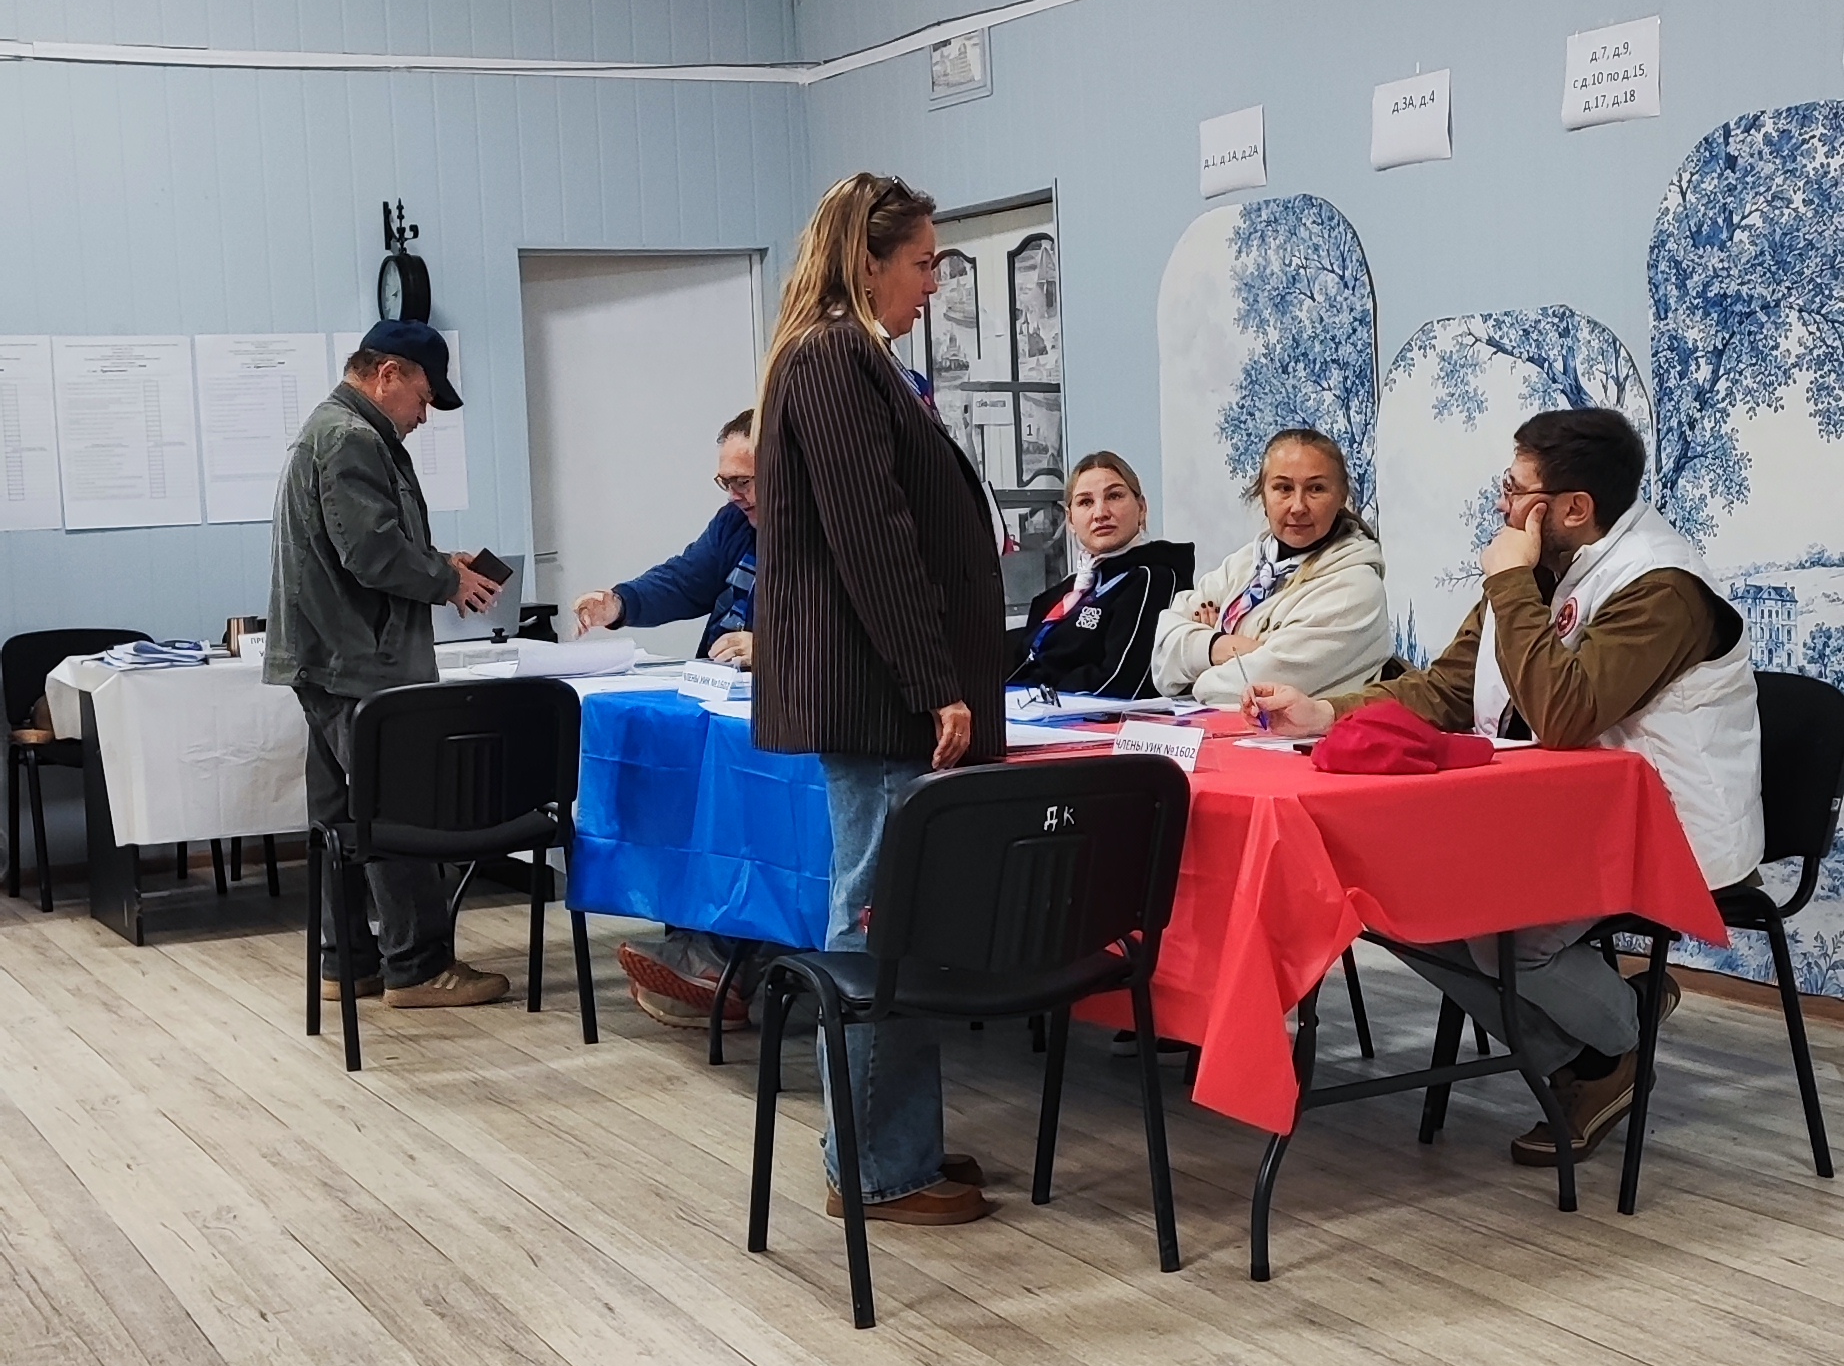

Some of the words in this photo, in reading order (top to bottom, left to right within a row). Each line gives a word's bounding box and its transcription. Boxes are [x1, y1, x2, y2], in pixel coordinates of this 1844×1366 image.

[1589, 45, 1610, 64] д.7,
[1612, 41, 1632, 59] д.9,
[1573, 79, 1579, 89] с
[1580, 71, 1604, 91] д.10
[1606, 71, 1620, 83] по
[1621, 63, 1648, 83] д.15,
[1391, 95, 1417, 115] д.3А,
[1418, 89, 1435, 109] д.4
[1583, 94, 1609, 113] д.17,
[1611, 89, 1636, 108] д.18
[1026, 423, 1034, 437] 1
[1115, 738, 1145, 753] ЧЛЕНЫ
[1145, 740, 1163, 755] УИК
[1163, 744, 1196, 759] №1602
